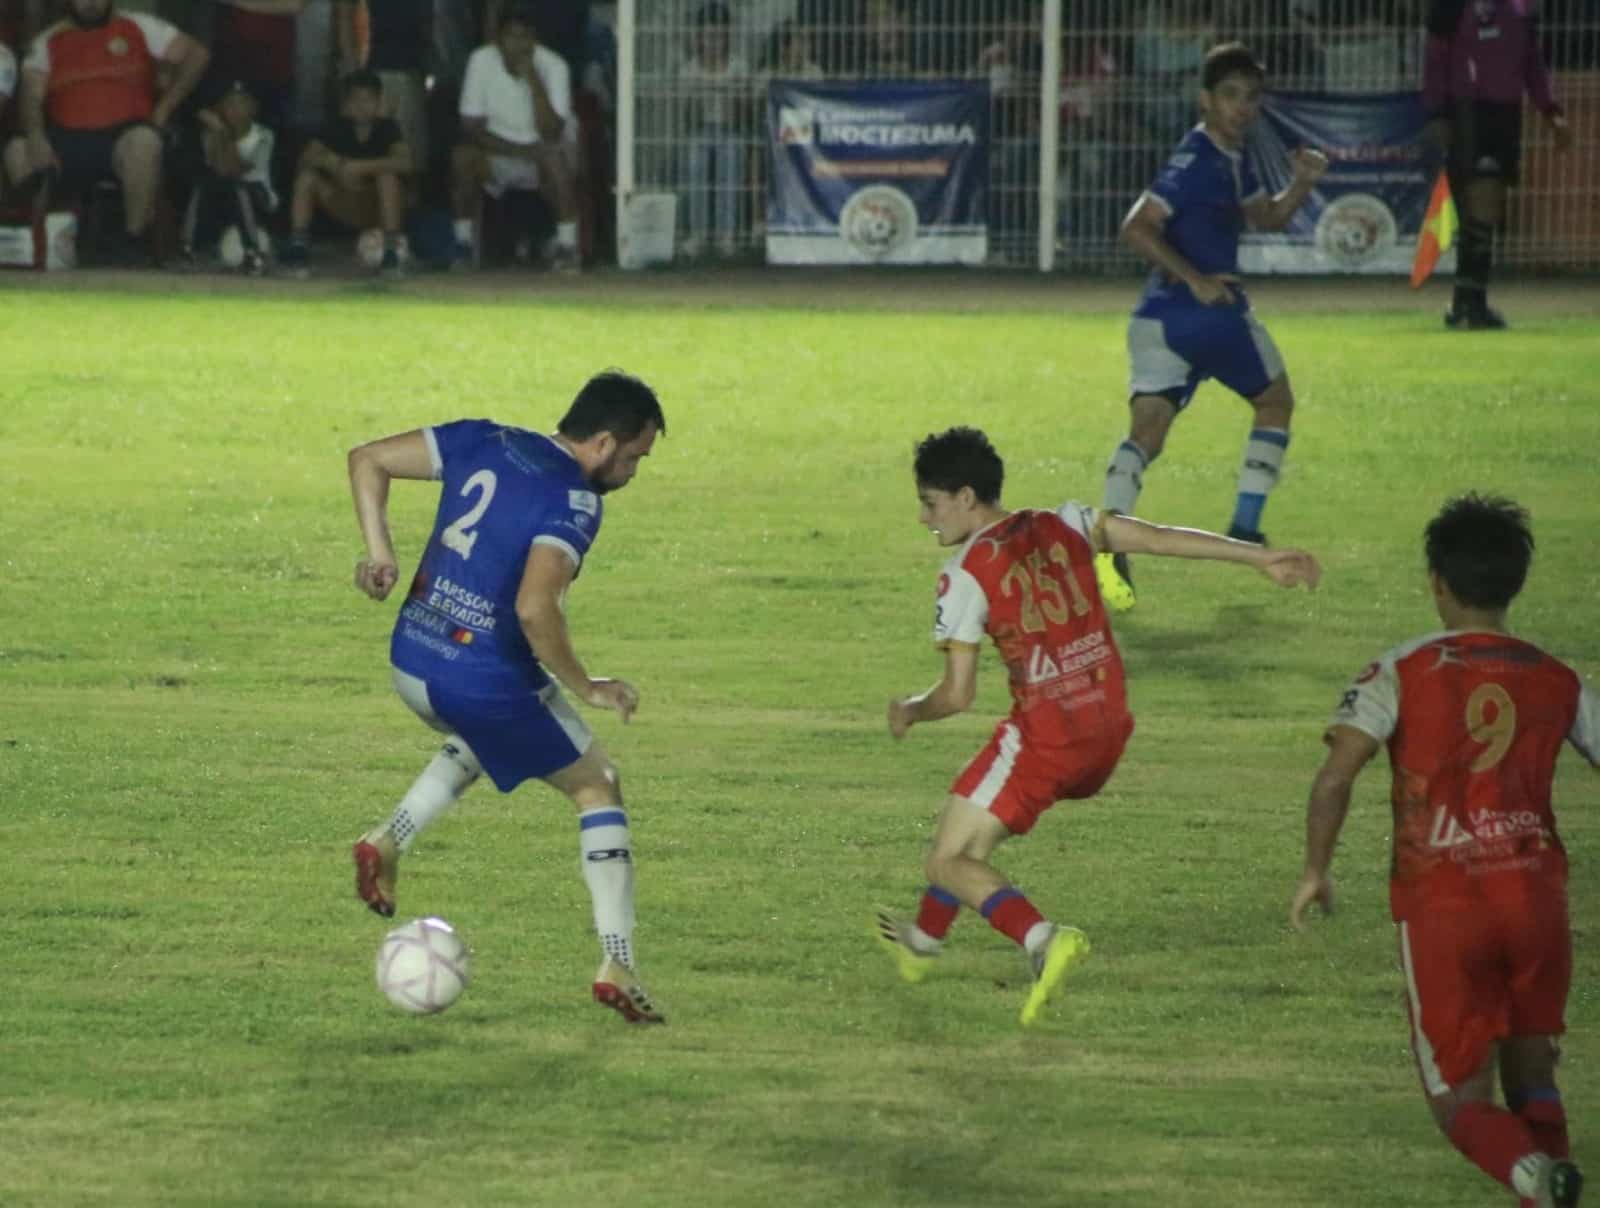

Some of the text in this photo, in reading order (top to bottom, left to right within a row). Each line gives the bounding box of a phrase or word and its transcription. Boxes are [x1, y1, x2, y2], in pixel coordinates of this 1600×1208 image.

[440, 468, 497, 560] 2
[1000, 541, 1091, 634] 251
[1465, 682, 1516, 773] 9
